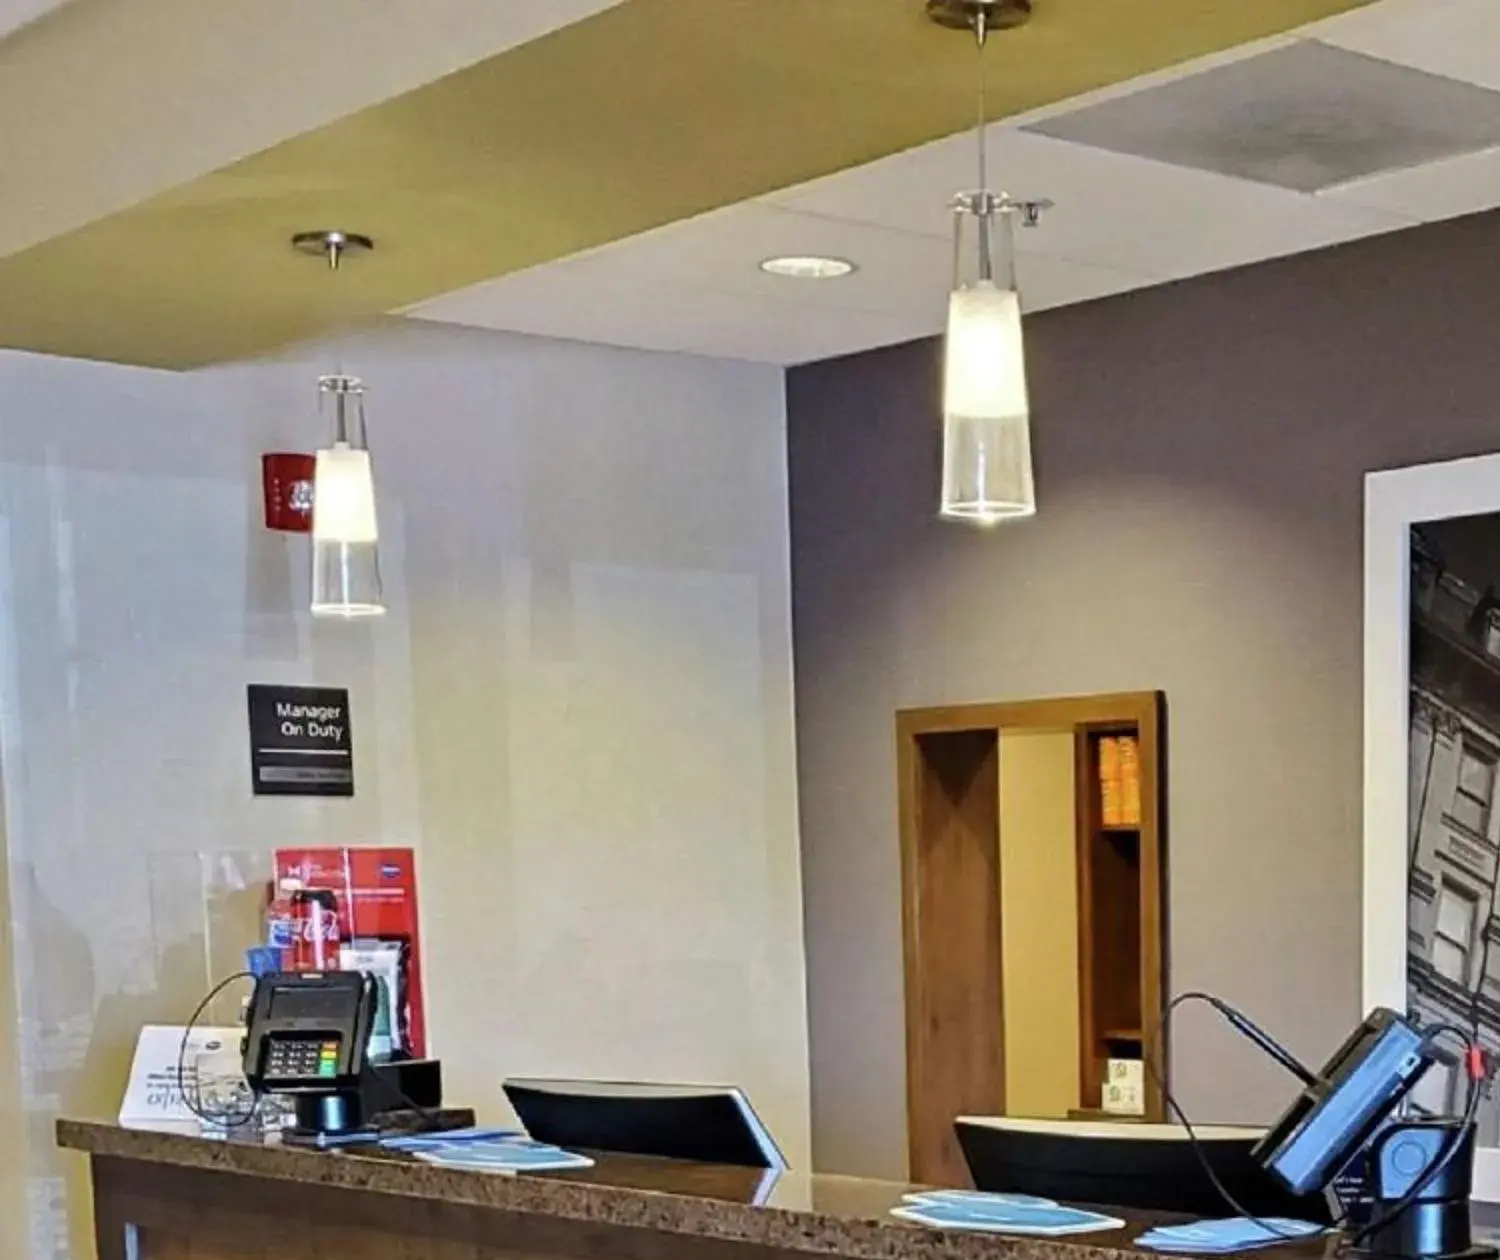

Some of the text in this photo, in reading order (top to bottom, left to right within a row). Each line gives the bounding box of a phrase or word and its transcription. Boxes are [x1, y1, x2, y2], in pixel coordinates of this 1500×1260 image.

[276, 702, 341, 721] Manager
[281, 722, 343, 743] On Duty
